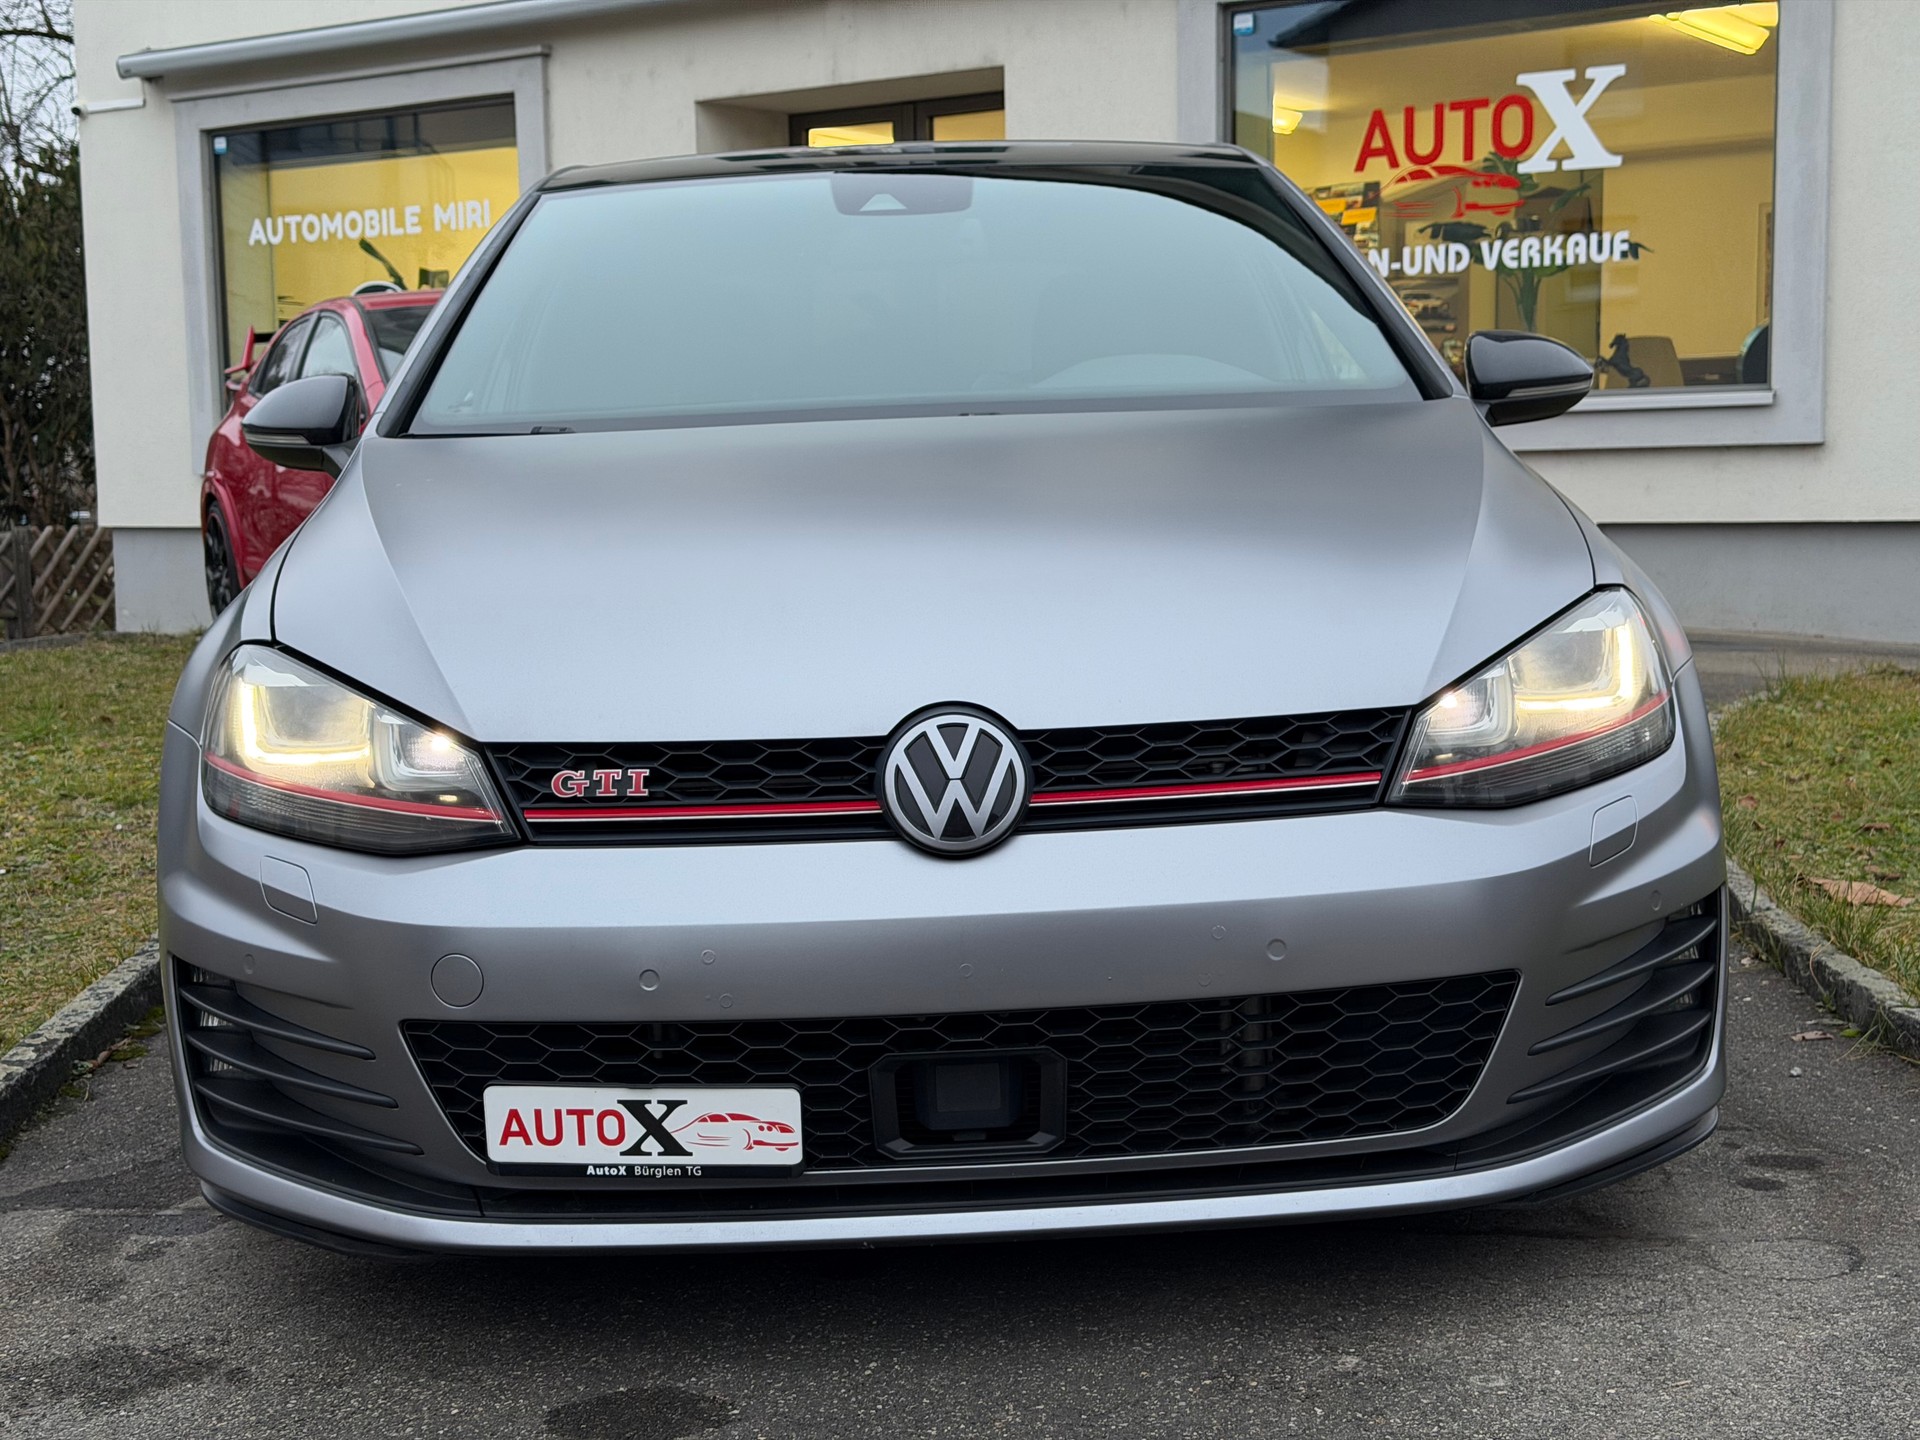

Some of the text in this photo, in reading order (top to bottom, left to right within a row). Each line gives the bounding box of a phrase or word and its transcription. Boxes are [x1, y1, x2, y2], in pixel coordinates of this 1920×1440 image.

[1354, 63, 1626, 173] AUTOX
[249, 198, 491, 246] AUTOMOBILE MIRI
[1368, 229, 1631, 278] N-UND VERKAUF
[550, 767, 651, 798] GTI
[499, 1099, 693, 1157] AUTOX
[586, 1165, 702, 1178] AutoX Bürglen TG
